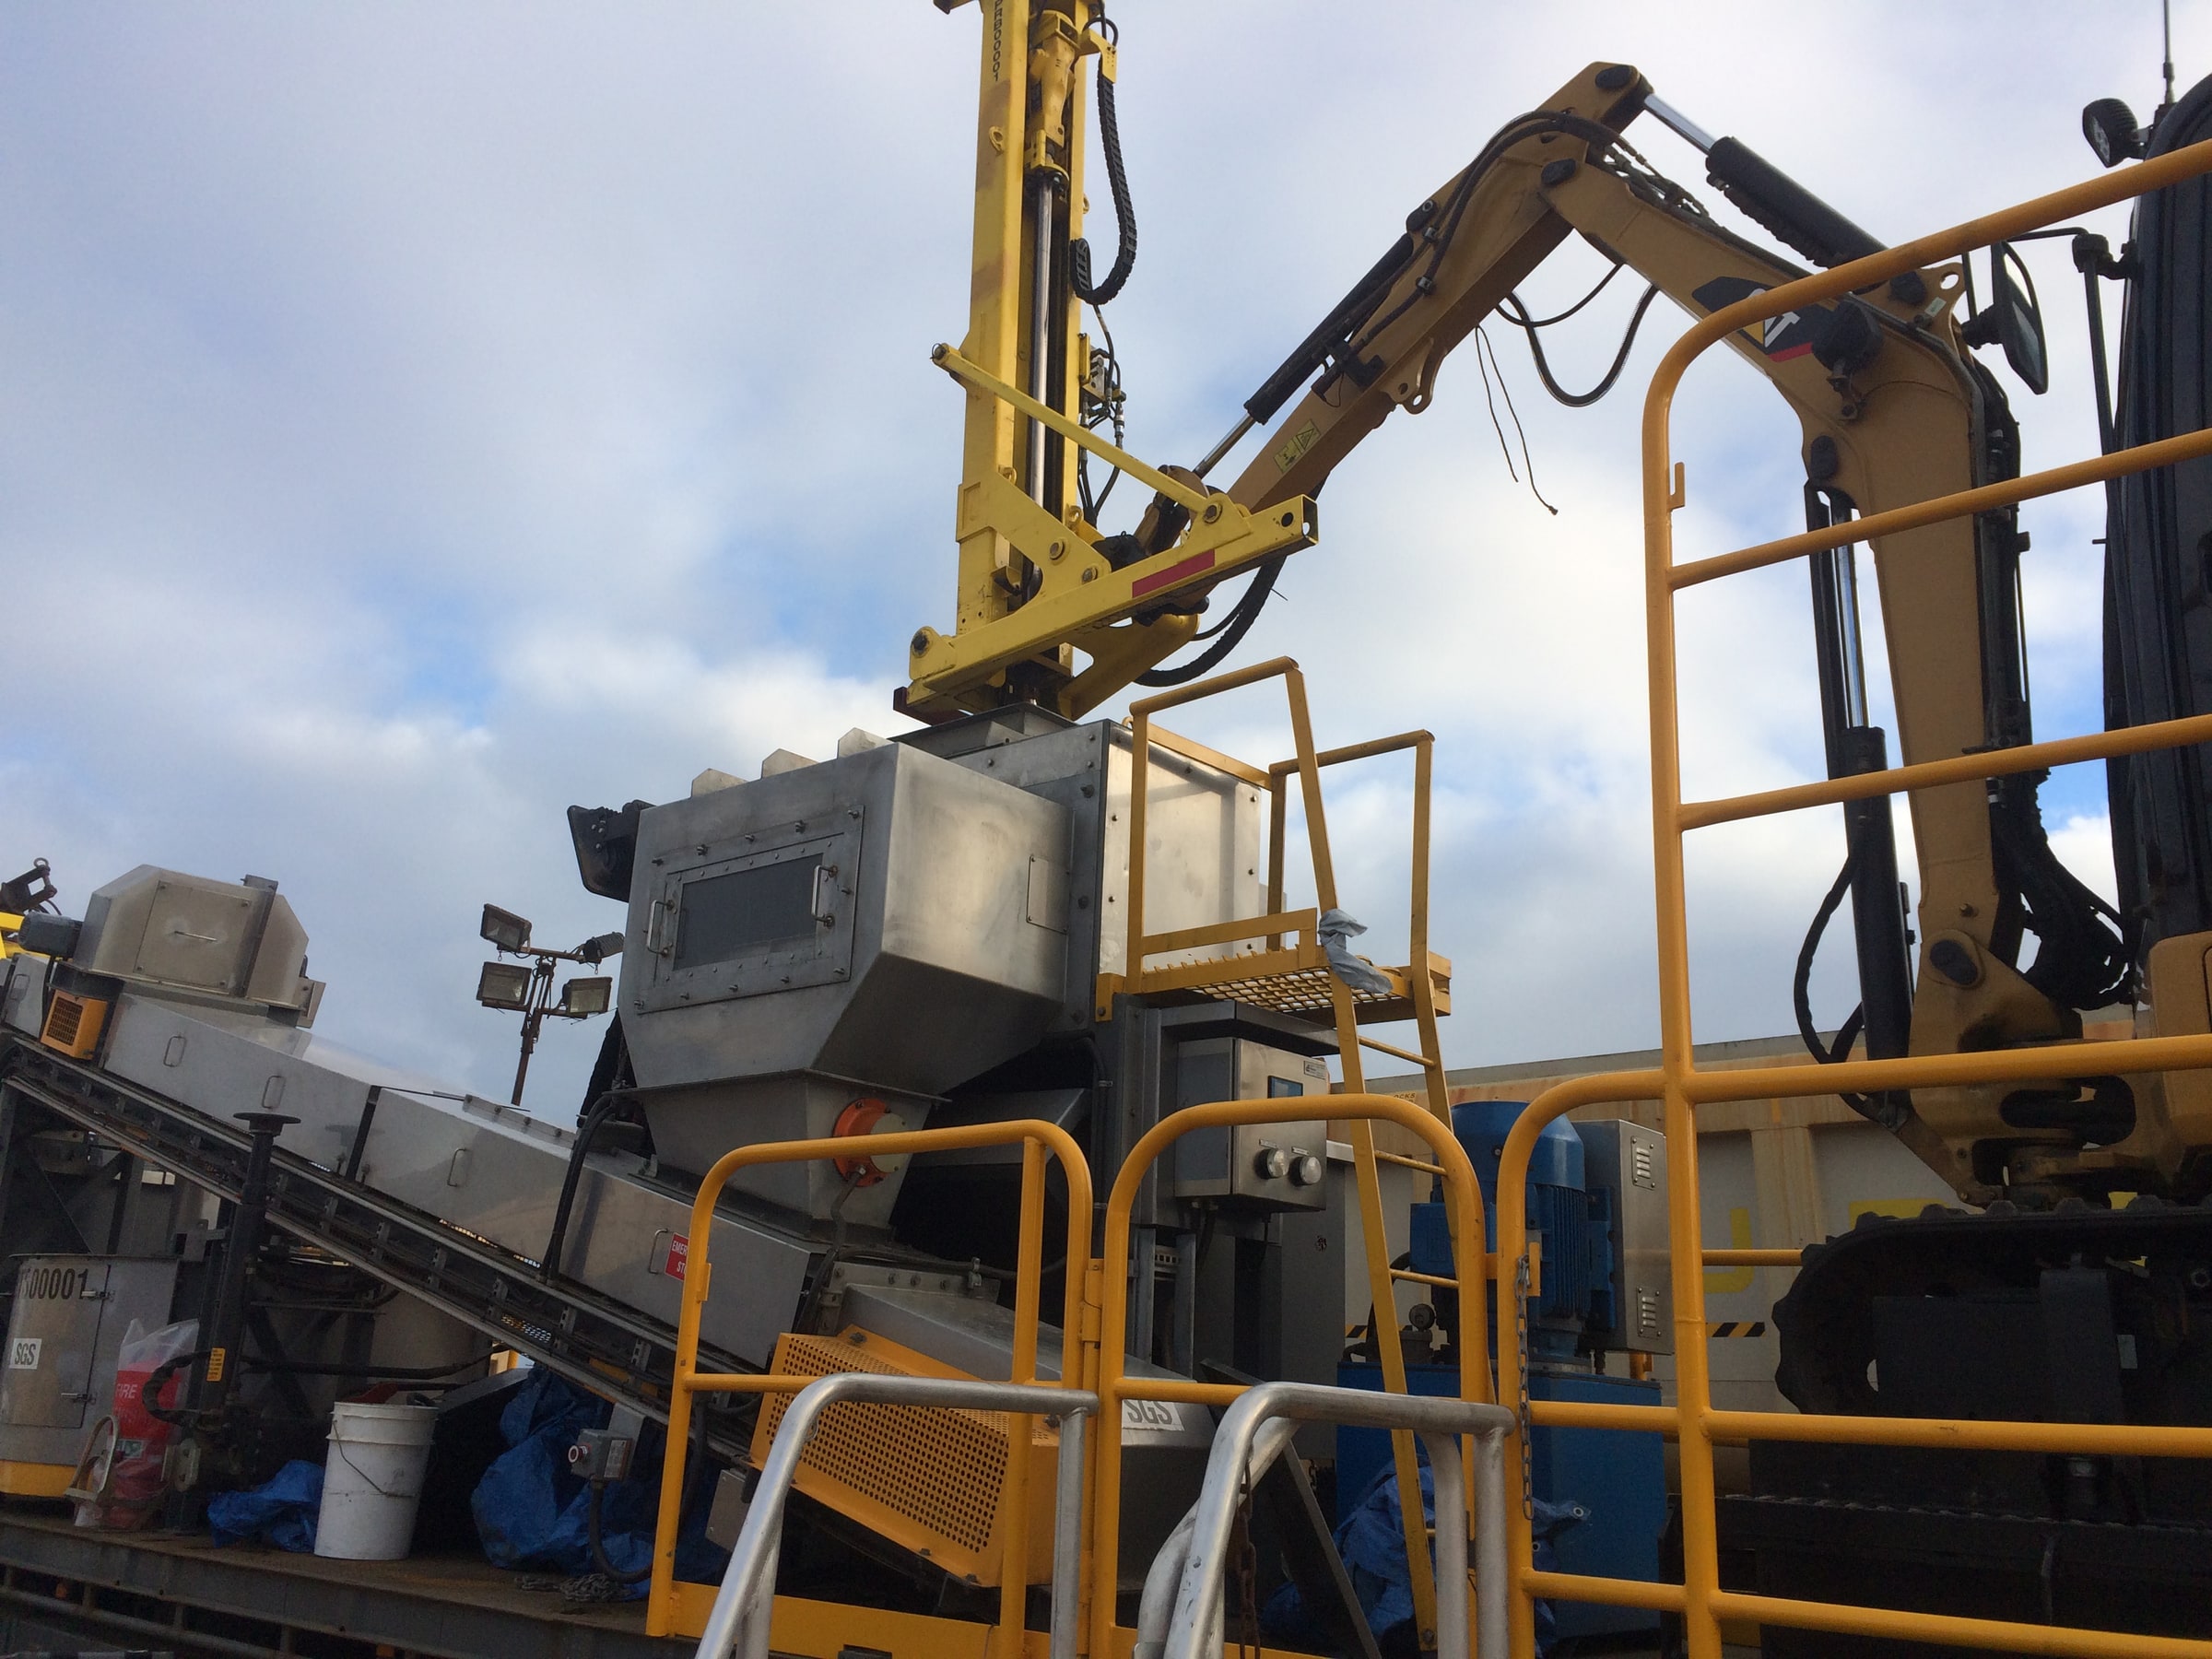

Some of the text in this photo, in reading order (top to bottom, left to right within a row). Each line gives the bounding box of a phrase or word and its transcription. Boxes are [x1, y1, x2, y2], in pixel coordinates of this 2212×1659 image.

[672, 1240, 688, 1256] EMER
[14, 1342, 36, 1366] SGS
[1124, 1399, 1173, 1425] SGS
